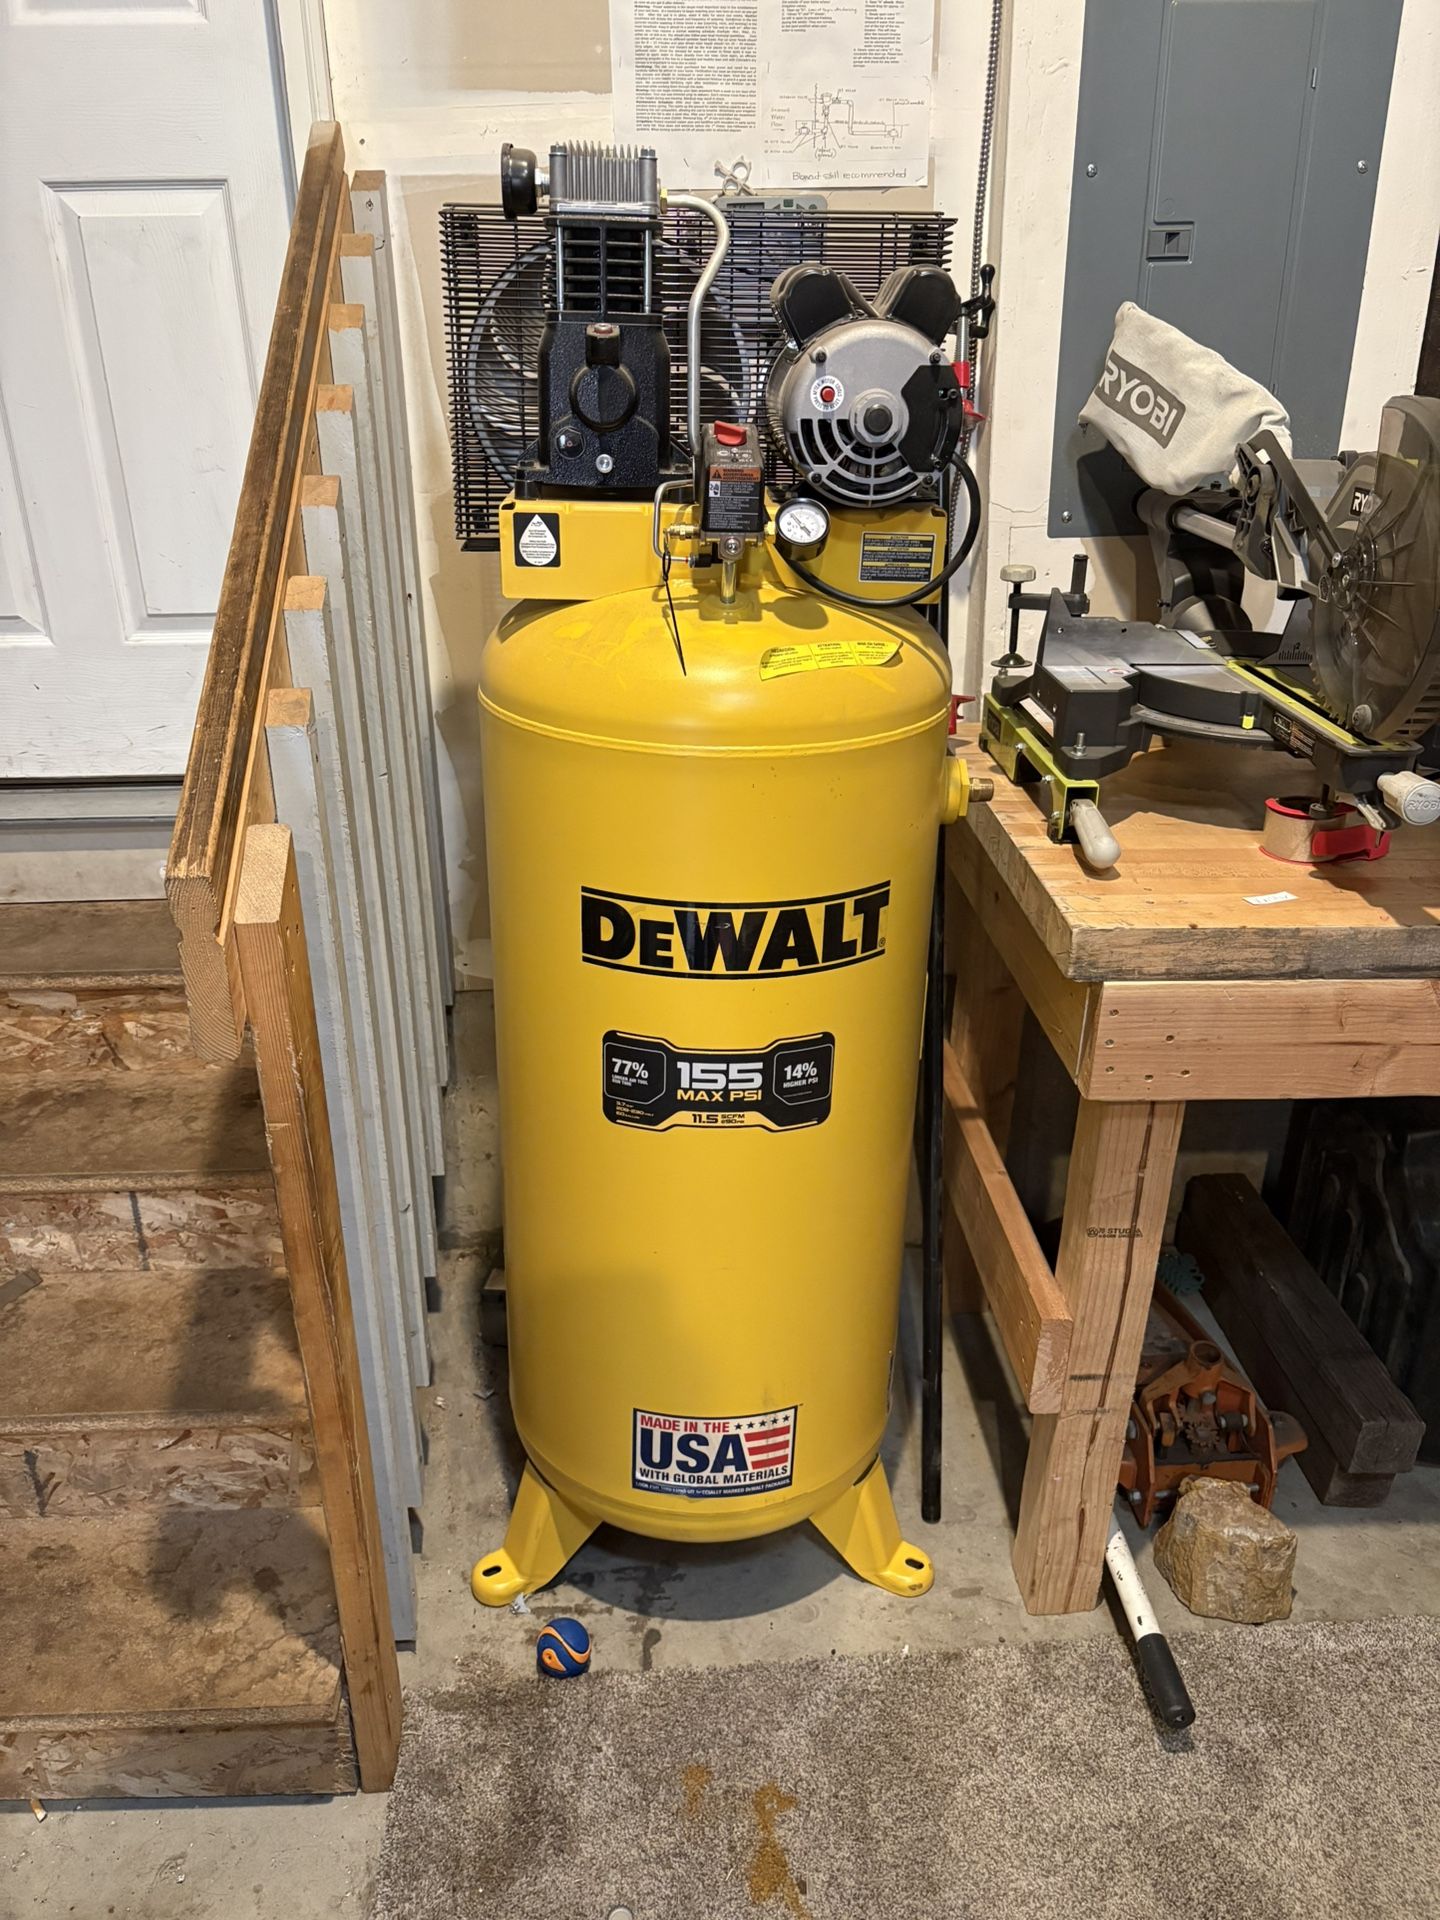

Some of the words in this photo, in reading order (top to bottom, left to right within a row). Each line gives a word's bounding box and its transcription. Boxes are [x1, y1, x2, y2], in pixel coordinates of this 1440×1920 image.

[843, 168, 907, 179] recommended
[1098, 360, 1178, 436] RYOBI
[612, 1058, 649, 1078] 77%
[676, 1062, 763, 1090] 155
[784, 1061, 818, 1080] 14%
[783, 1080, 806, 1088] HIGHER
[676, 1089, 724, 1102] MAX
[730, 1090, 762, 1102] PSI
[692, 1114, 718, 1124] 11.5
[640, 1415, 680, 1432] MADE
[684, 1421, 698, 1432] IN
[704, 1422, 730, 1433] THE
[640, 1428, 748, 1474] USA
[640, 1468, 669, 1482] WITH
[673, 1473, 717, 1485] GLOBAL
[723, 1465, 788, 1484] MATERIALS
